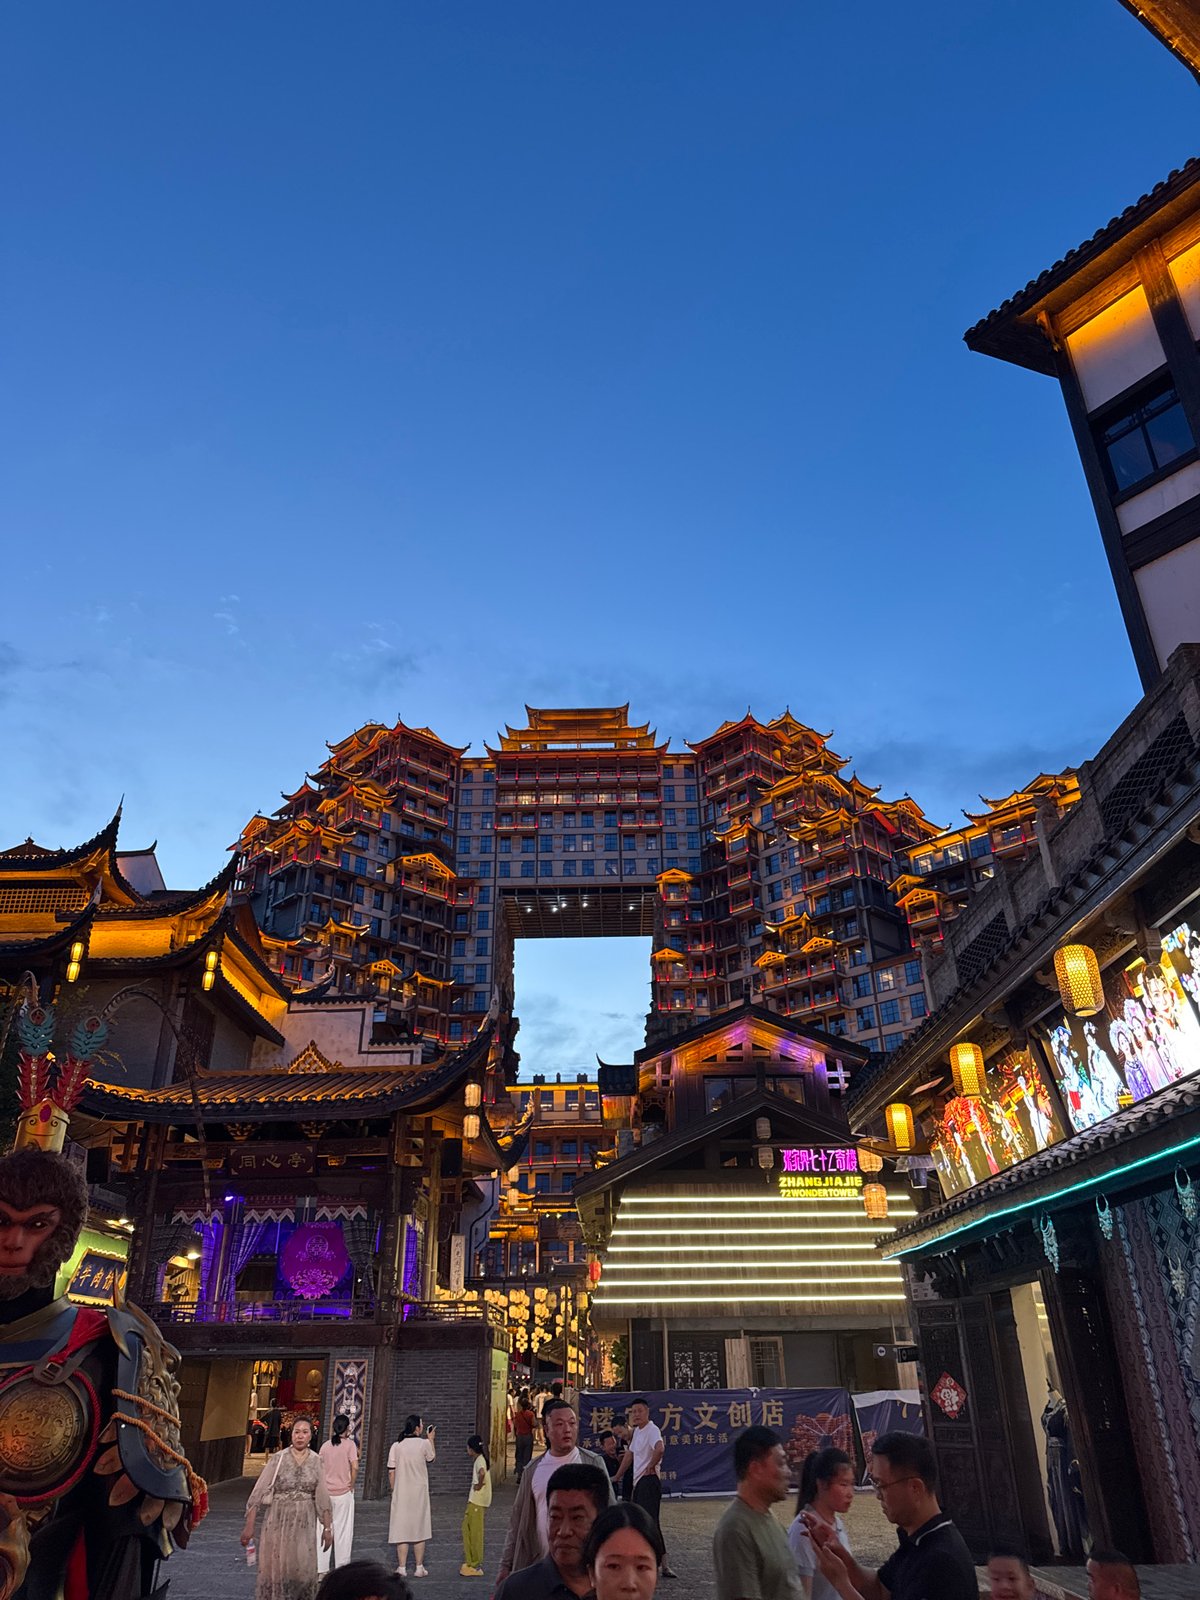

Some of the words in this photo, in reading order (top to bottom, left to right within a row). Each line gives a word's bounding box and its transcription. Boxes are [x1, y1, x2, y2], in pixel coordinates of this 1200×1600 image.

[239, 1152, 306, 1169] 同心亭
[779, 1176, 862, 1187] ZHANGJIAJIE
